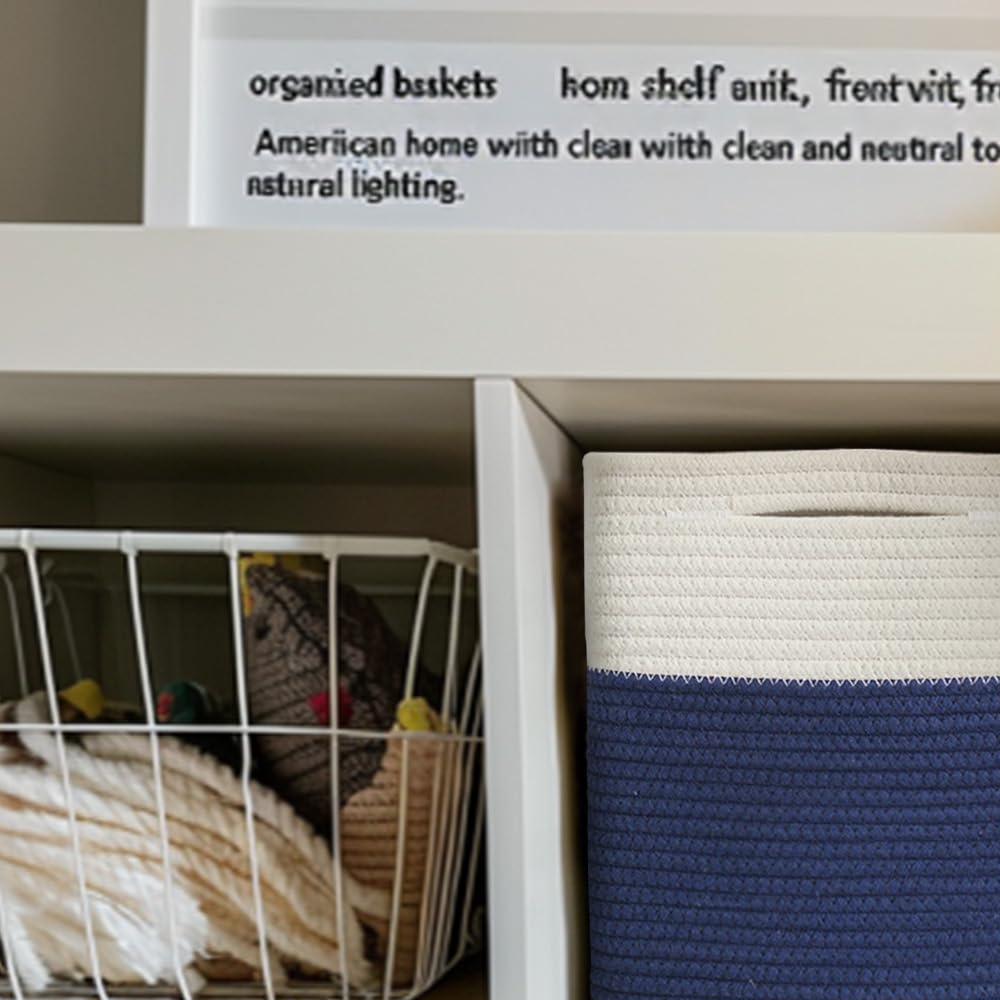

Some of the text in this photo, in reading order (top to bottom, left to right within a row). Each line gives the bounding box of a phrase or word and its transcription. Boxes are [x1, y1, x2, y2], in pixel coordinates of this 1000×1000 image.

[405, 128, 479, 157] home
[722, 130, 794, 161] clean
[802, 132, 851, 162] and
